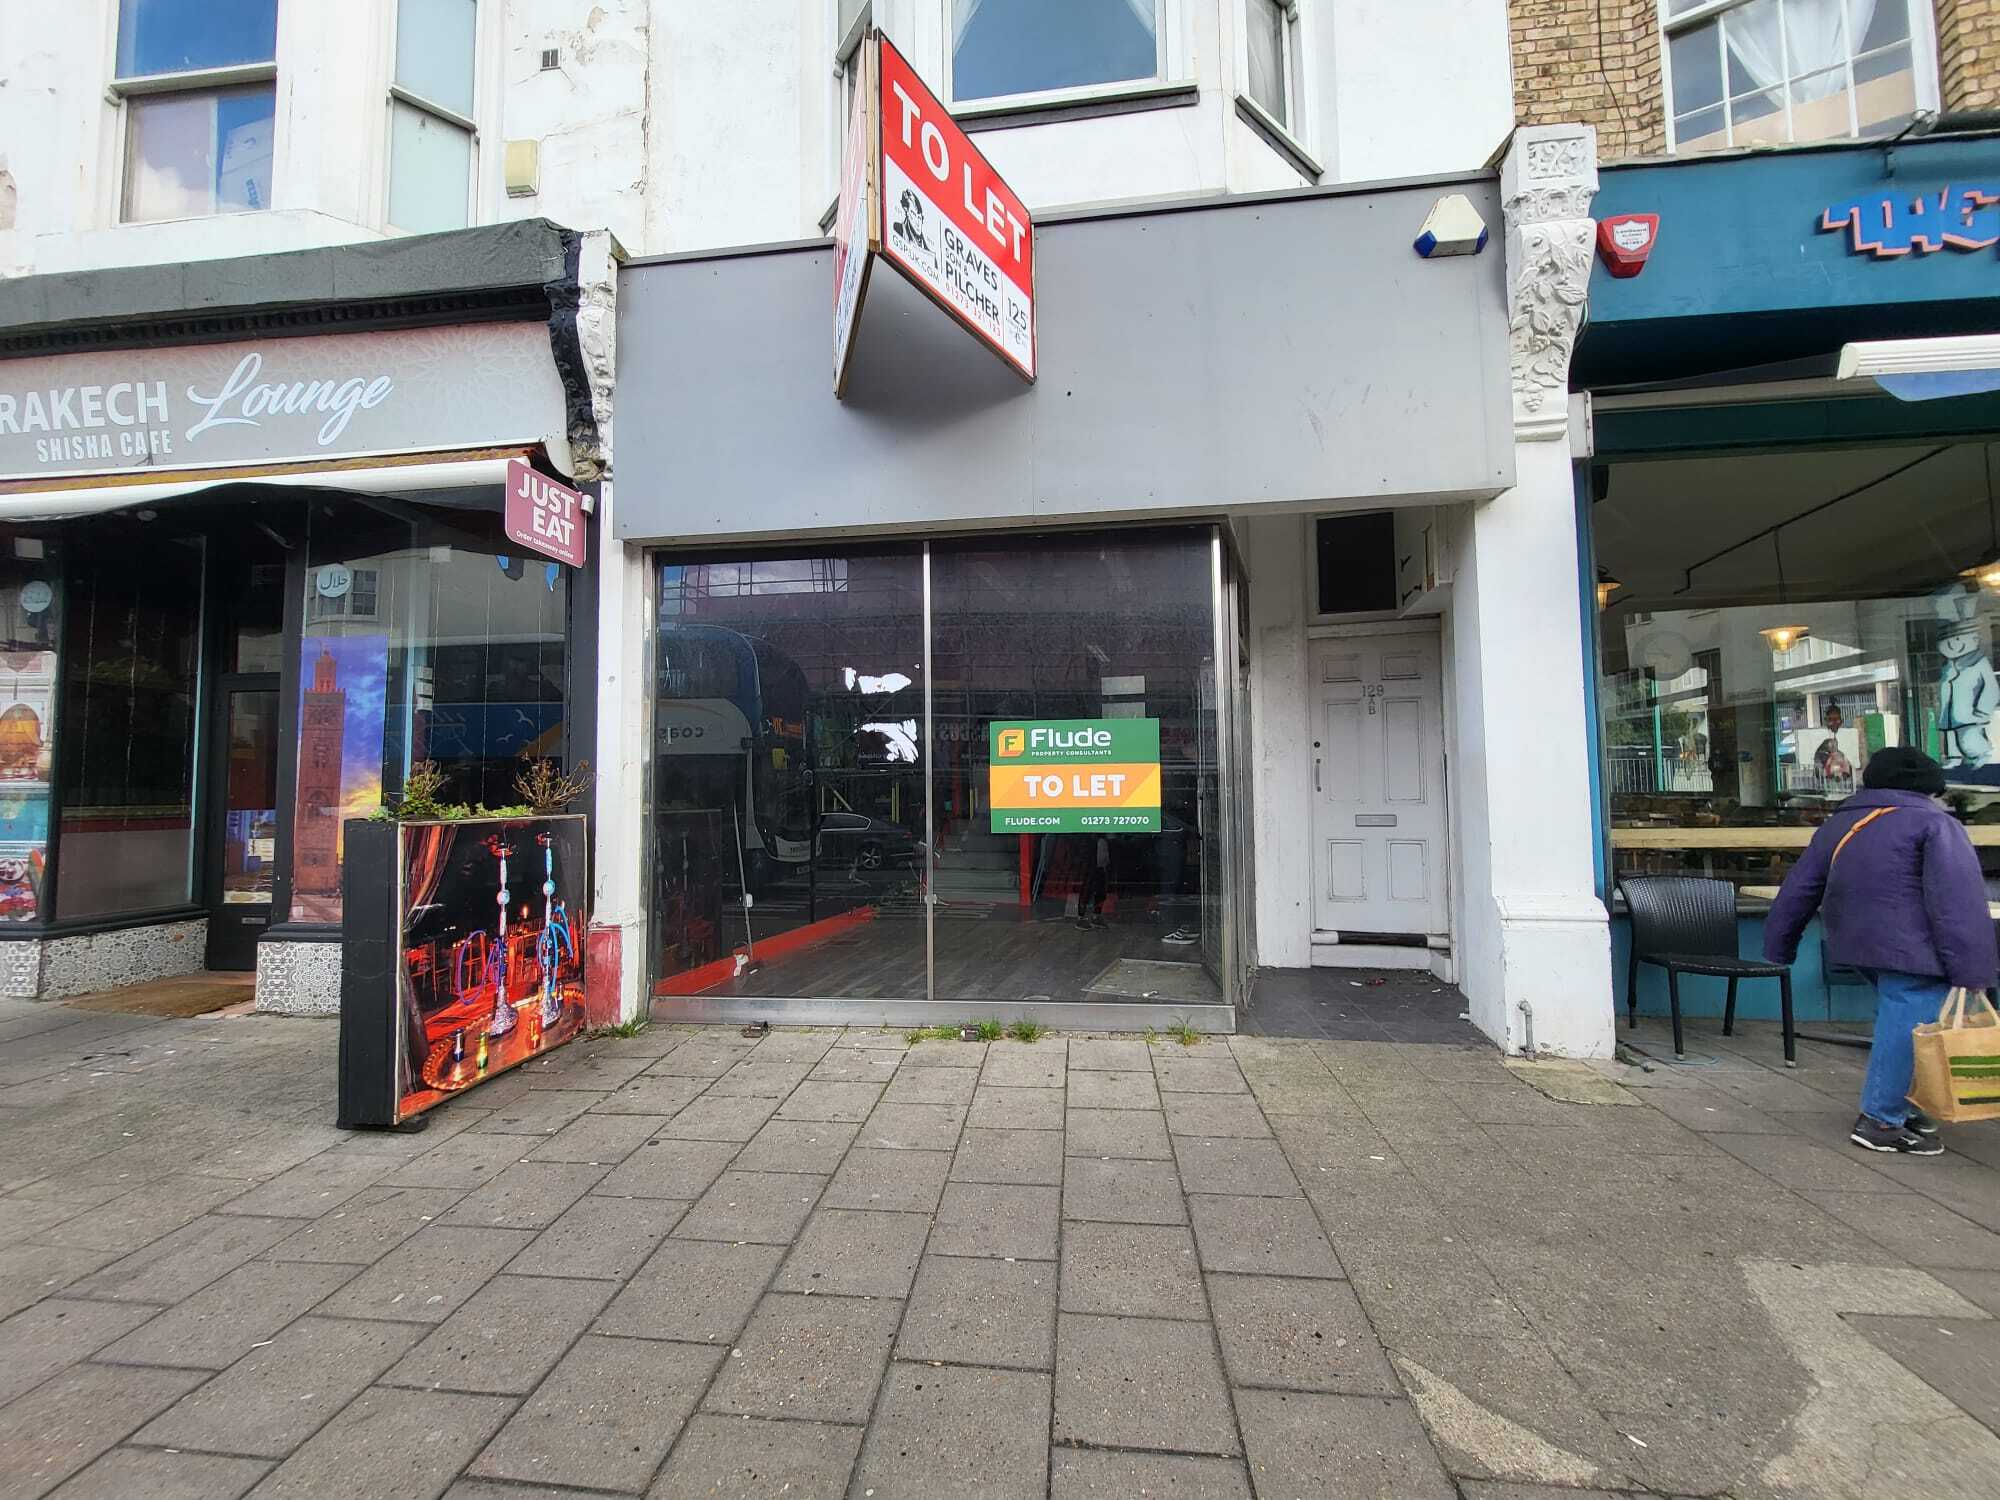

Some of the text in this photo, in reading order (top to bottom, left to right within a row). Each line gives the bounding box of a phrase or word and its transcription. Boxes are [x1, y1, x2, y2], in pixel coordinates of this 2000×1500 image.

[893, 80, 1026, 264] TO LET
[945, 228, 998, 291] GRAVES
[946, 247, 962, 267] SON
[945, 260, 1000, 325] PILCHER
[1008, 297, 1027, 331] 125
[185, 352, 394, 446] Lounge
[36, 429, 173, 462] SHISHA CAFE
[517, 472, 575, 520] JUST
[516, 529, 533, 542] Order
[532, 505, 575, 547] EAT
[1005, 728, 1112, 752] F Flude
[1023, 774, 1126, 798] TO LET
[1004, 816, 1150, 826] FLUDE.COM 01273 727070
